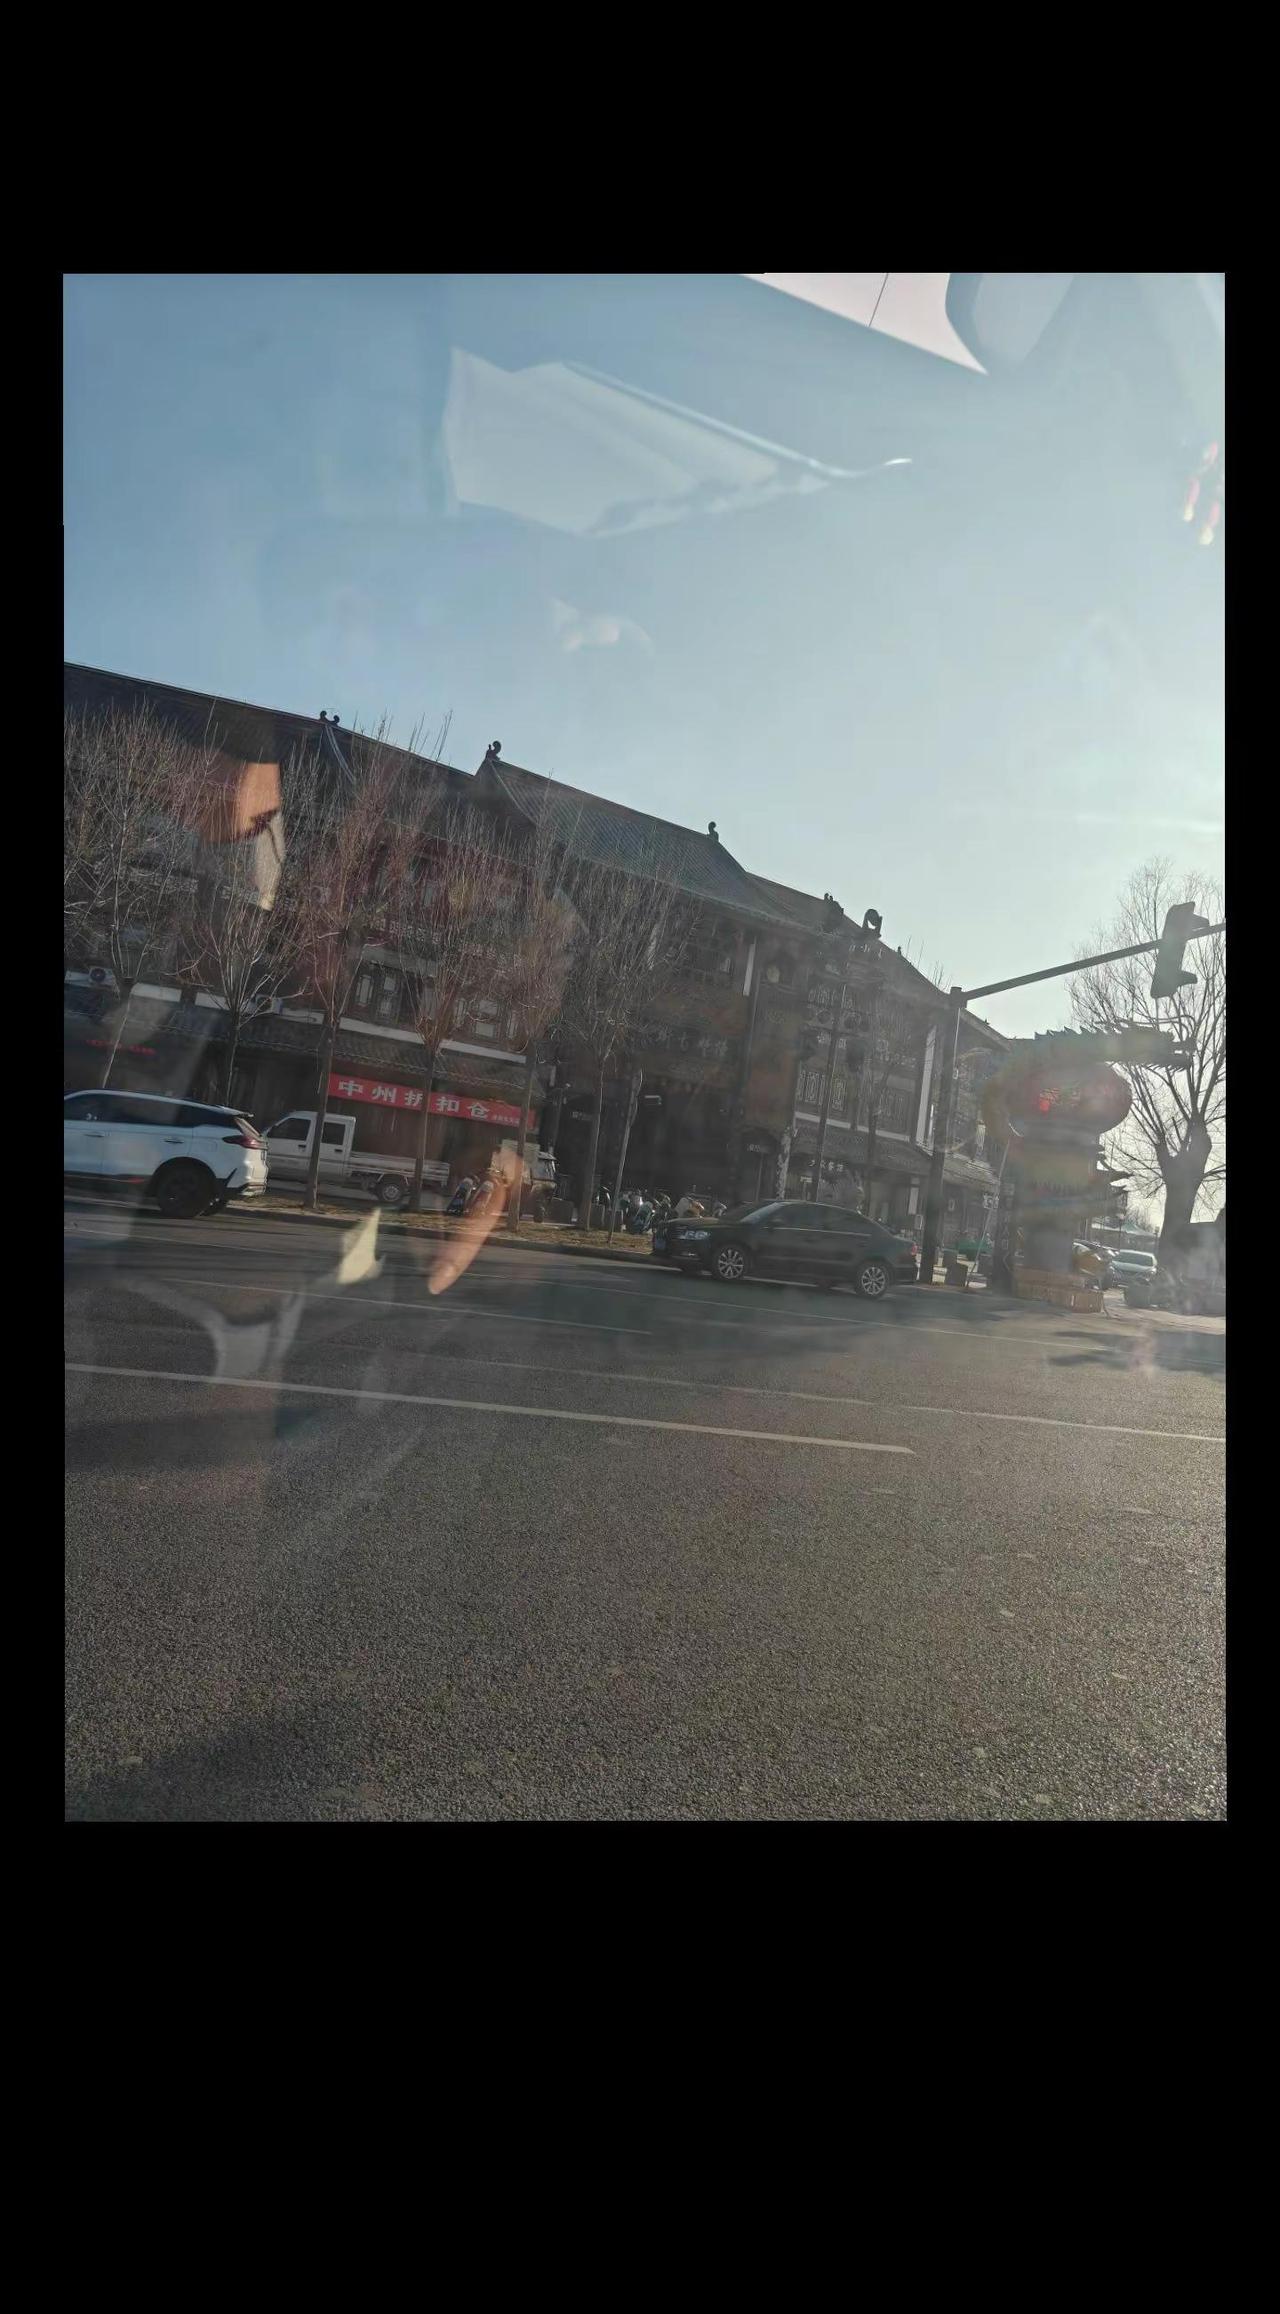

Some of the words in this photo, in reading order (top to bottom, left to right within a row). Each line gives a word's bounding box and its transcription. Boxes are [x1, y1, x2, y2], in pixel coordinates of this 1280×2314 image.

[338, 1079, 490, 1120] 中州折扣仓
